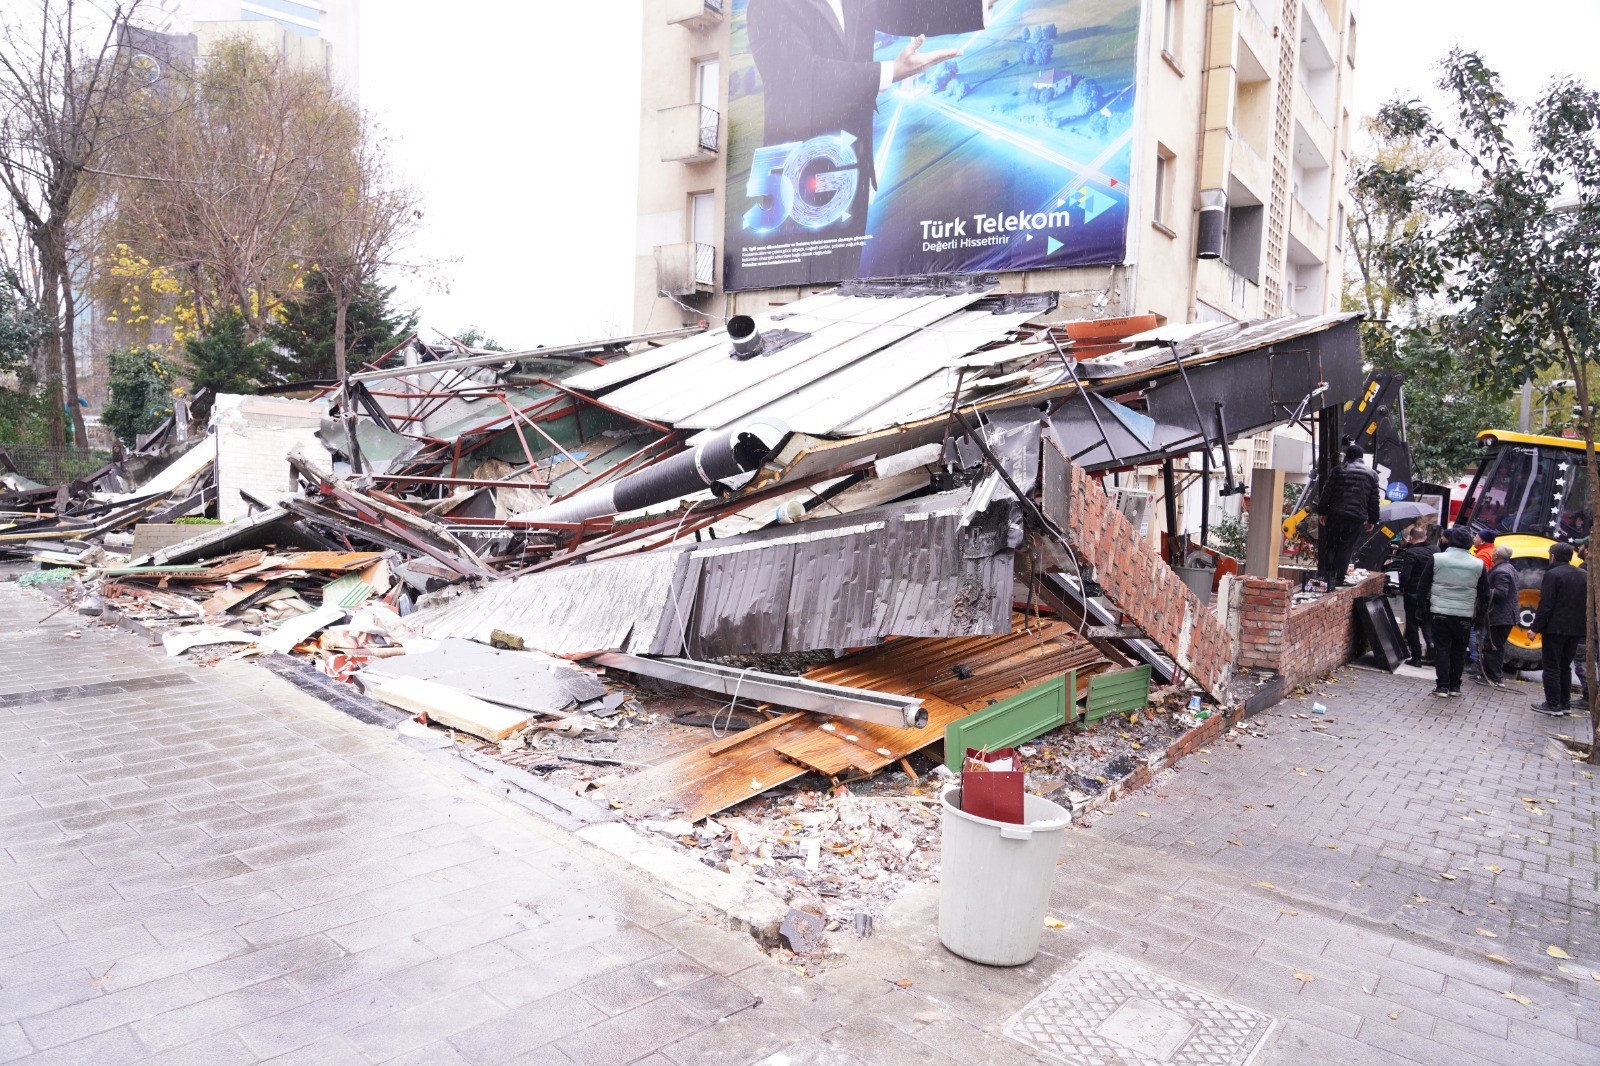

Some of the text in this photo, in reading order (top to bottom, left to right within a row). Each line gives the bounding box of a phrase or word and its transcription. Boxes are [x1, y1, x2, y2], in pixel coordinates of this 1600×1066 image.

[743, 132, 858, 232] 5G
[920, 209, 1070, 240] Türk Telekom
[922, 234, 1010, 252] Değerli Hissettirir
